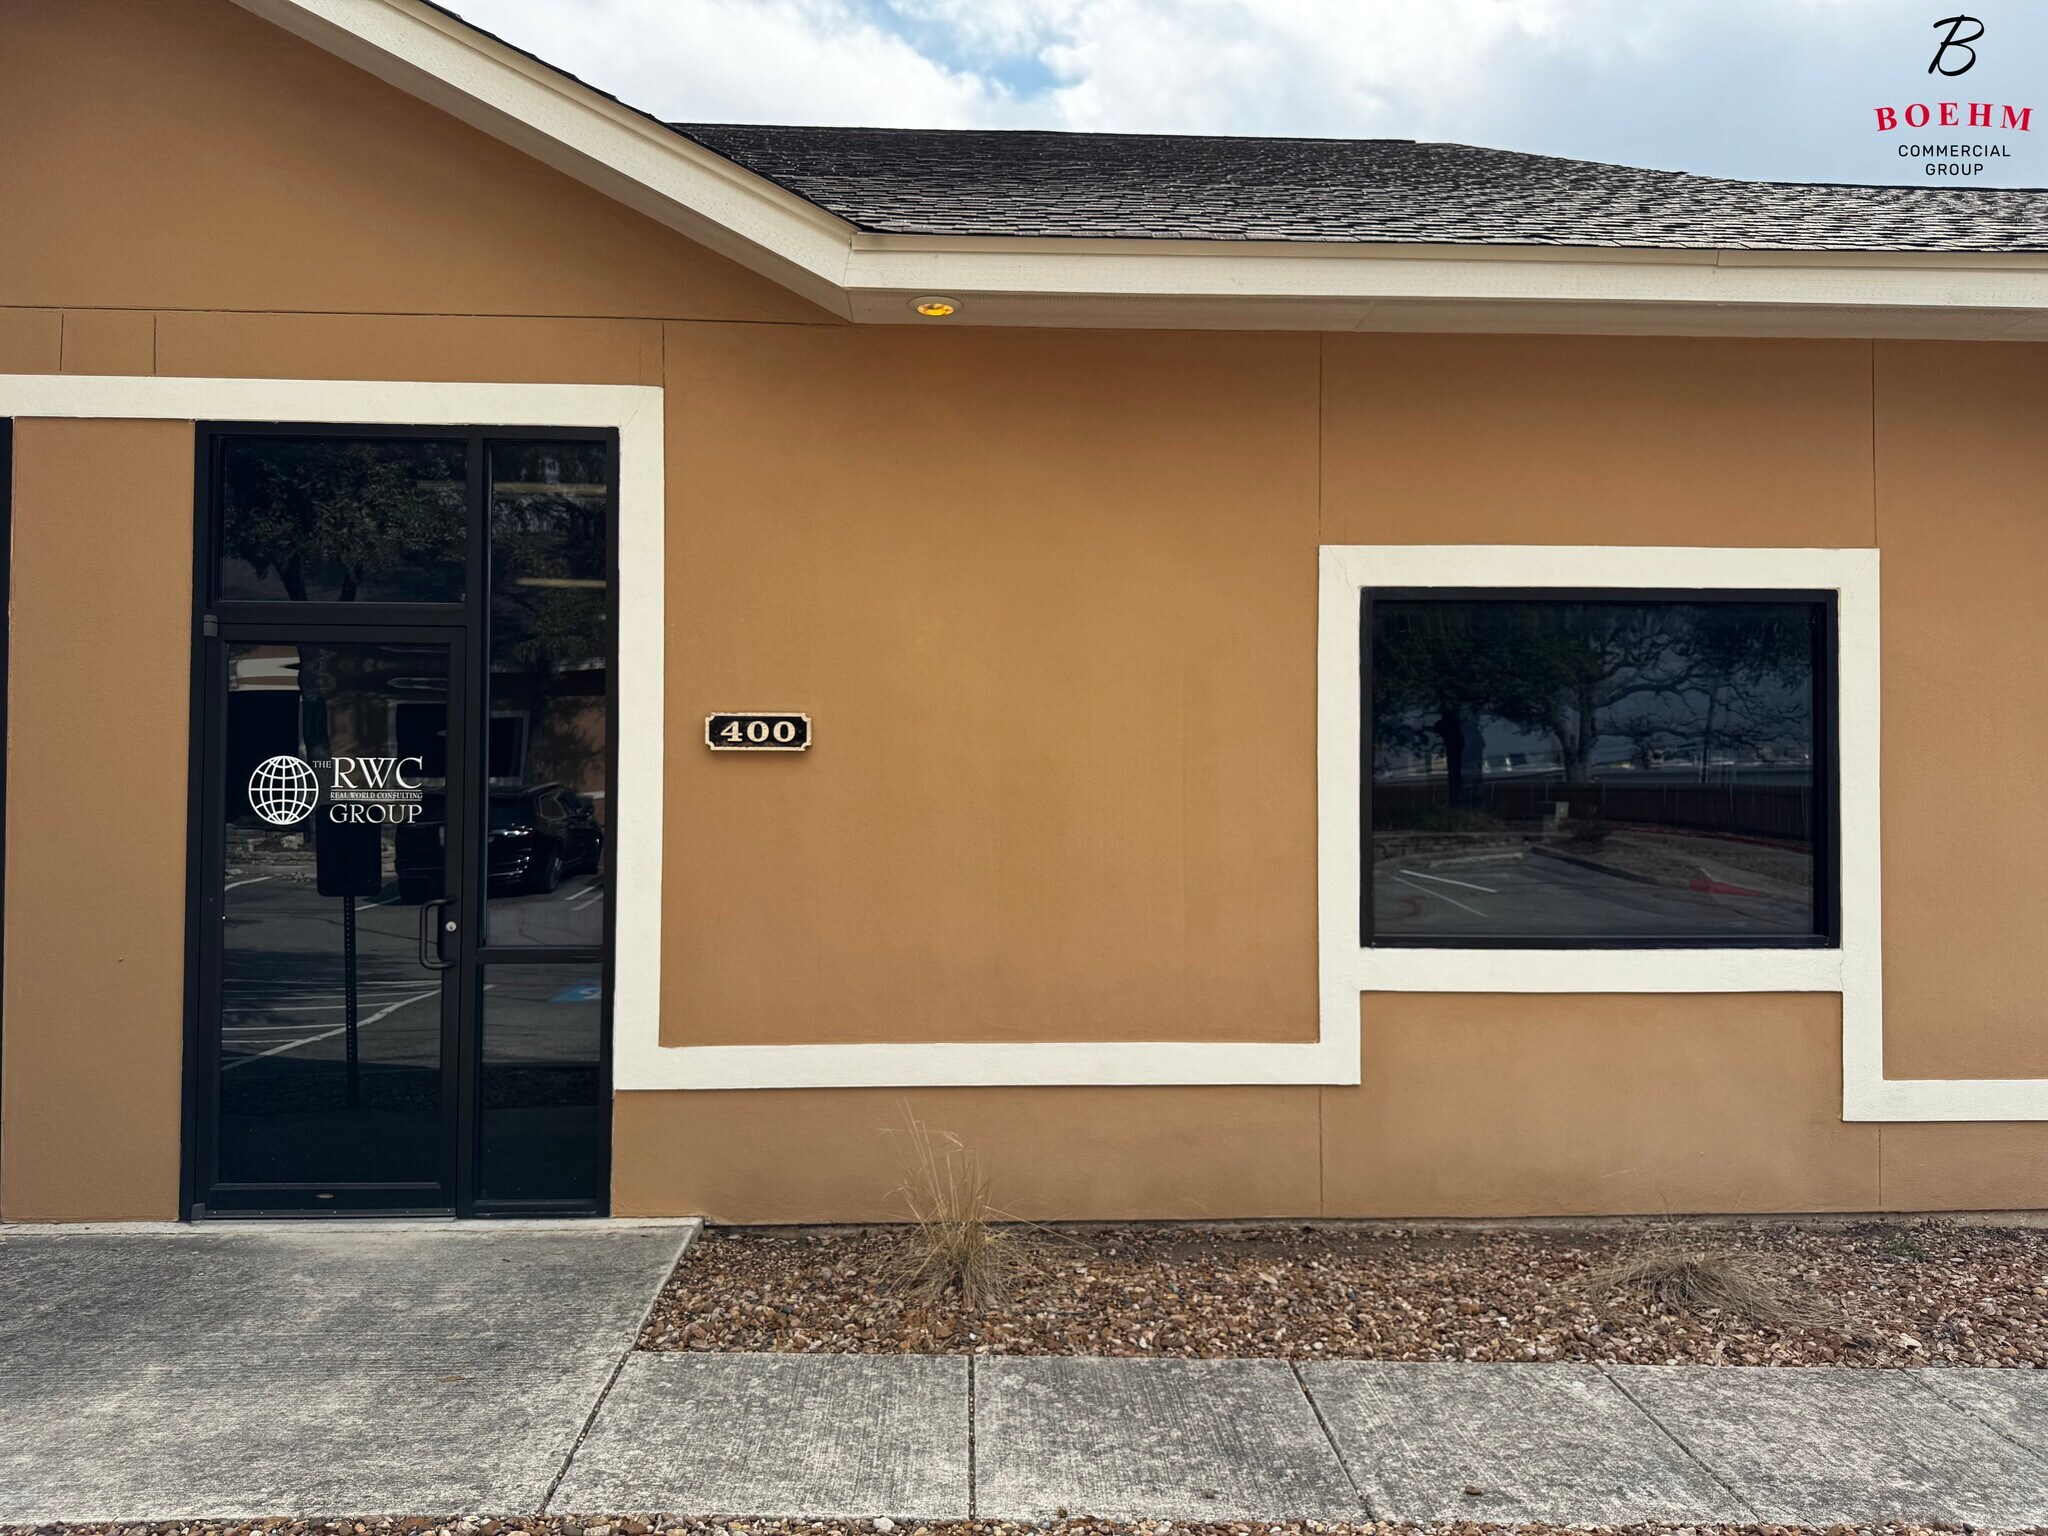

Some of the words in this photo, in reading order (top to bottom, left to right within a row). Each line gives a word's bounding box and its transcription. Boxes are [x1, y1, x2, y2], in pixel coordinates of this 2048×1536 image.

[720, 720, 796, 743] 400
[312, 760, 332, 769] THE
[330, 755, 423, 789] RWC
[330, 791, 348, 799] REAL
[349, 791, 376, 799] WORLD
[376, 791, 423, 799] CONSULTING
[329, 803, 423, 824] GROUP
